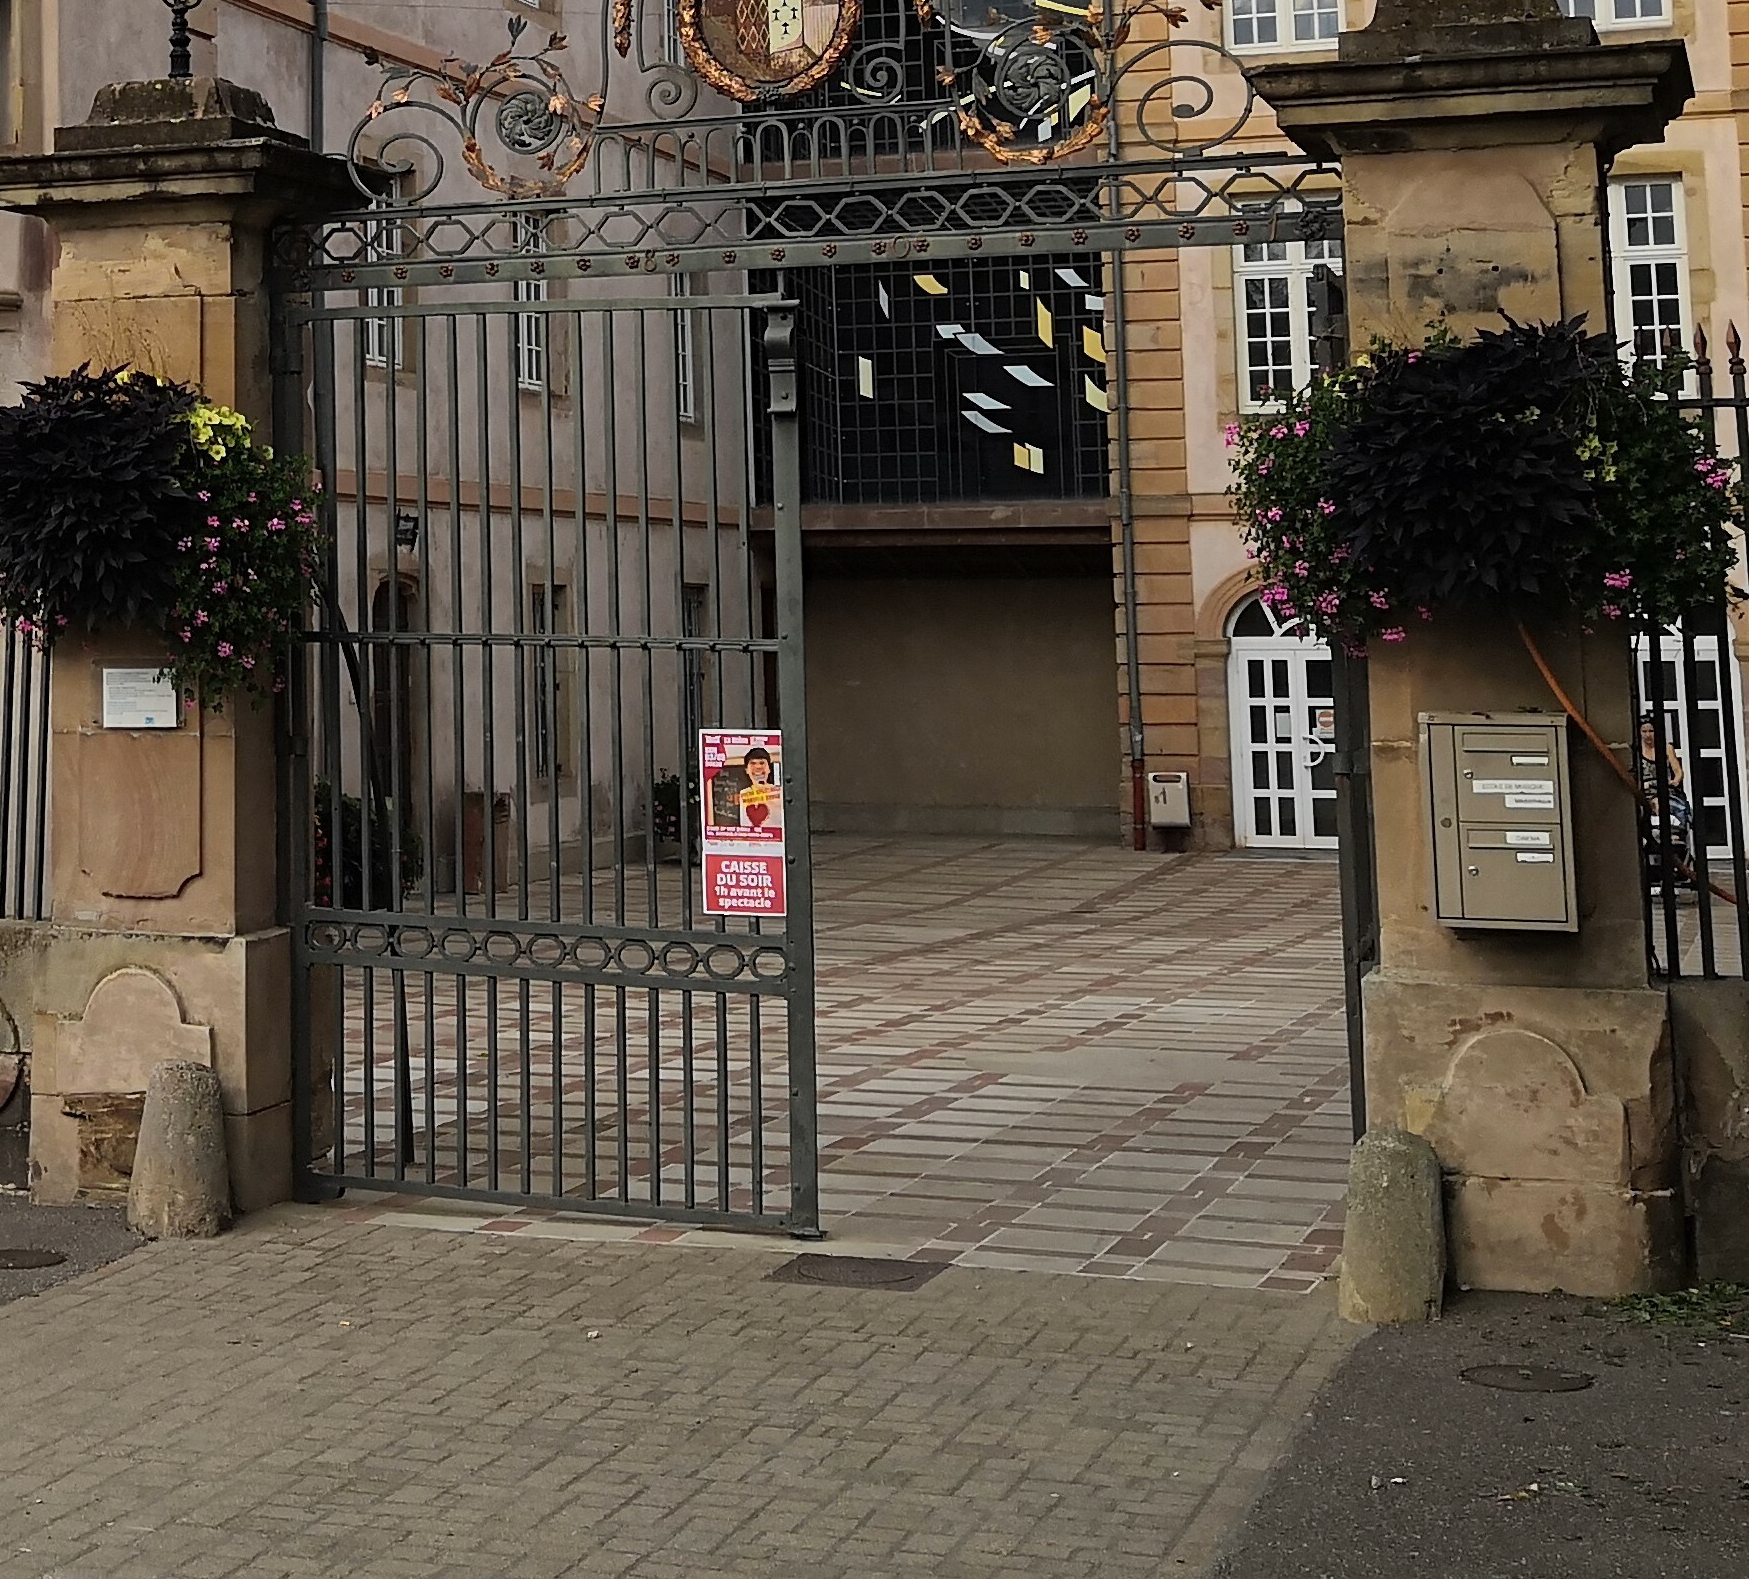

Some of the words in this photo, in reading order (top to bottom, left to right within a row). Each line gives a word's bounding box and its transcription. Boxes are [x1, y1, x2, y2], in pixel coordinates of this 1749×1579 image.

[721, 860, 767, 874] CAISSE
[716, 873, 737, 886] DU
[739, 874, 772, 887] SOIR
[714, 886, 728, 896] 1h
[730, 887, 763, 897] avant
[764, 887, 776, 898] le
[718, 897, 772, 910] spectacle
